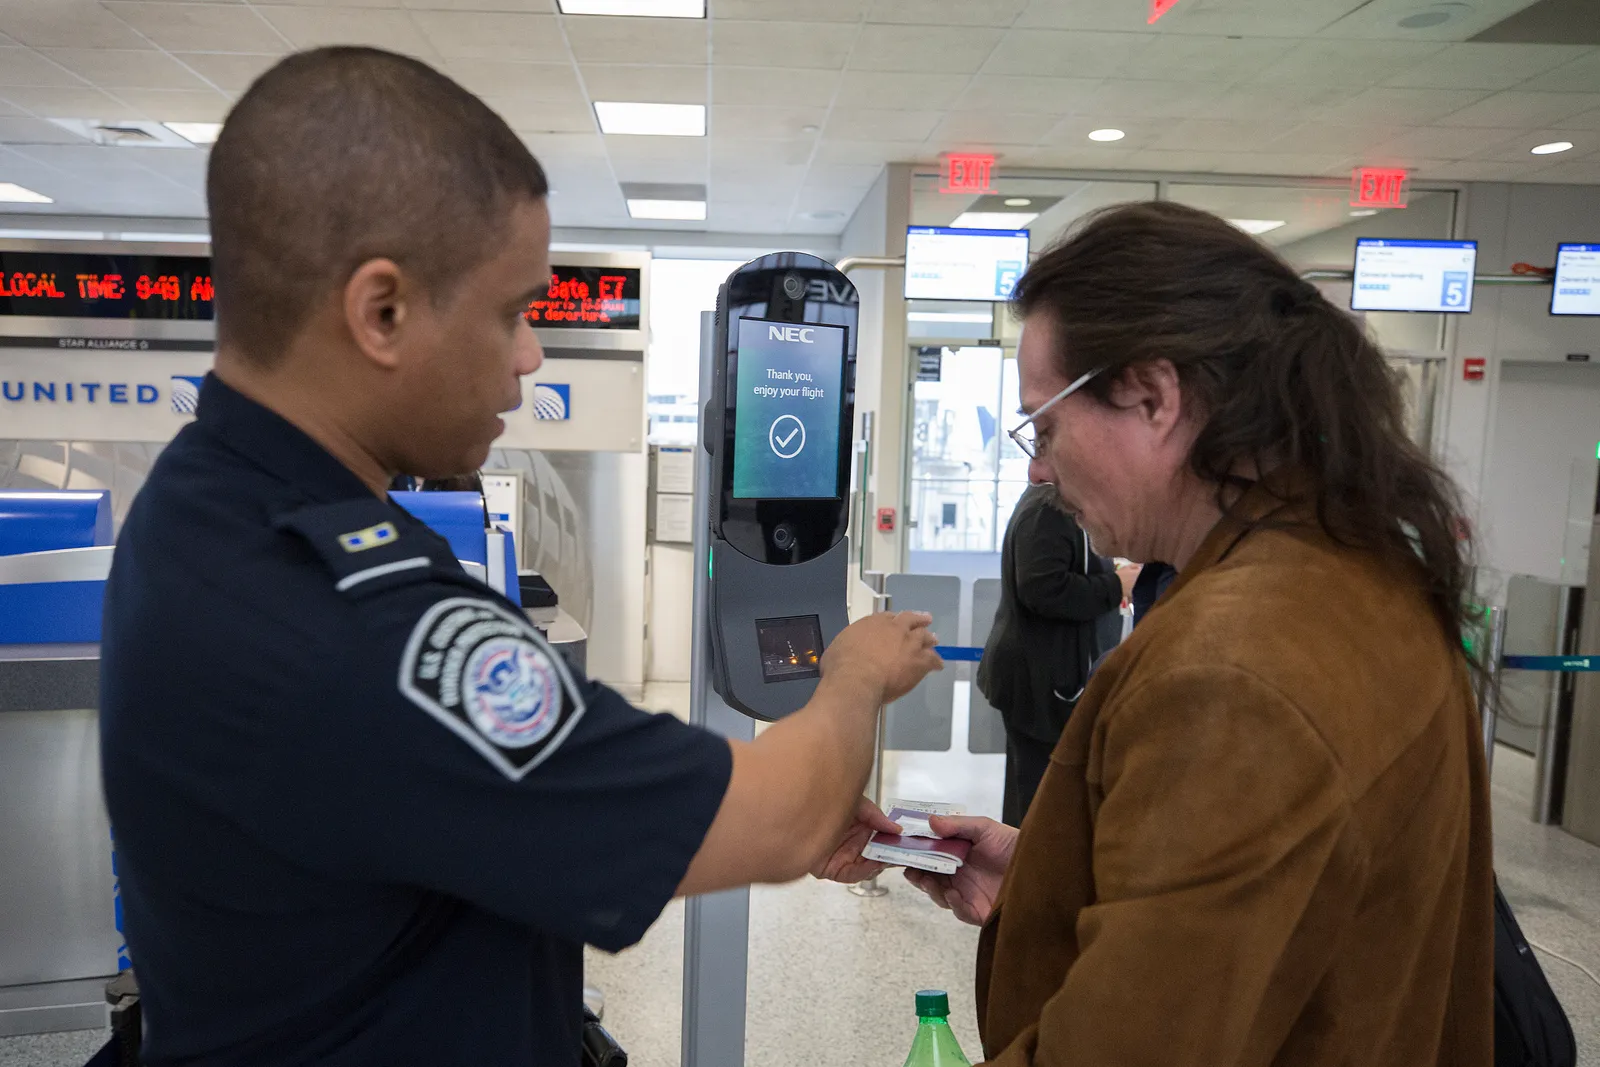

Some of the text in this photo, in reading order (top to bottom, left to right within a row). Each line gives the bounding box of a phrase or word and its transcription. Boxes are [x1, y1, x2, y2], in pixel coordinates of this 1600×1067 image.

[949, 159, 993, 189] EXIT
[1361, 173, 1405, 204] EXIT
[0, 271, 65, 298] LOCAL
[547, 274, 627, 300] Gate E7
[1000, 271, 1016, 295] 5
[1445, 281, 1463, 306] 5
[59, 339, 137, 350] STAR ALLIANCE
[768, 325, 815, 344] NEC
[766, 368, 813, 383] Thank you,
[2, 381, 159, 404] UNITED
[753, 384, 824, 400] enjoy your flight
